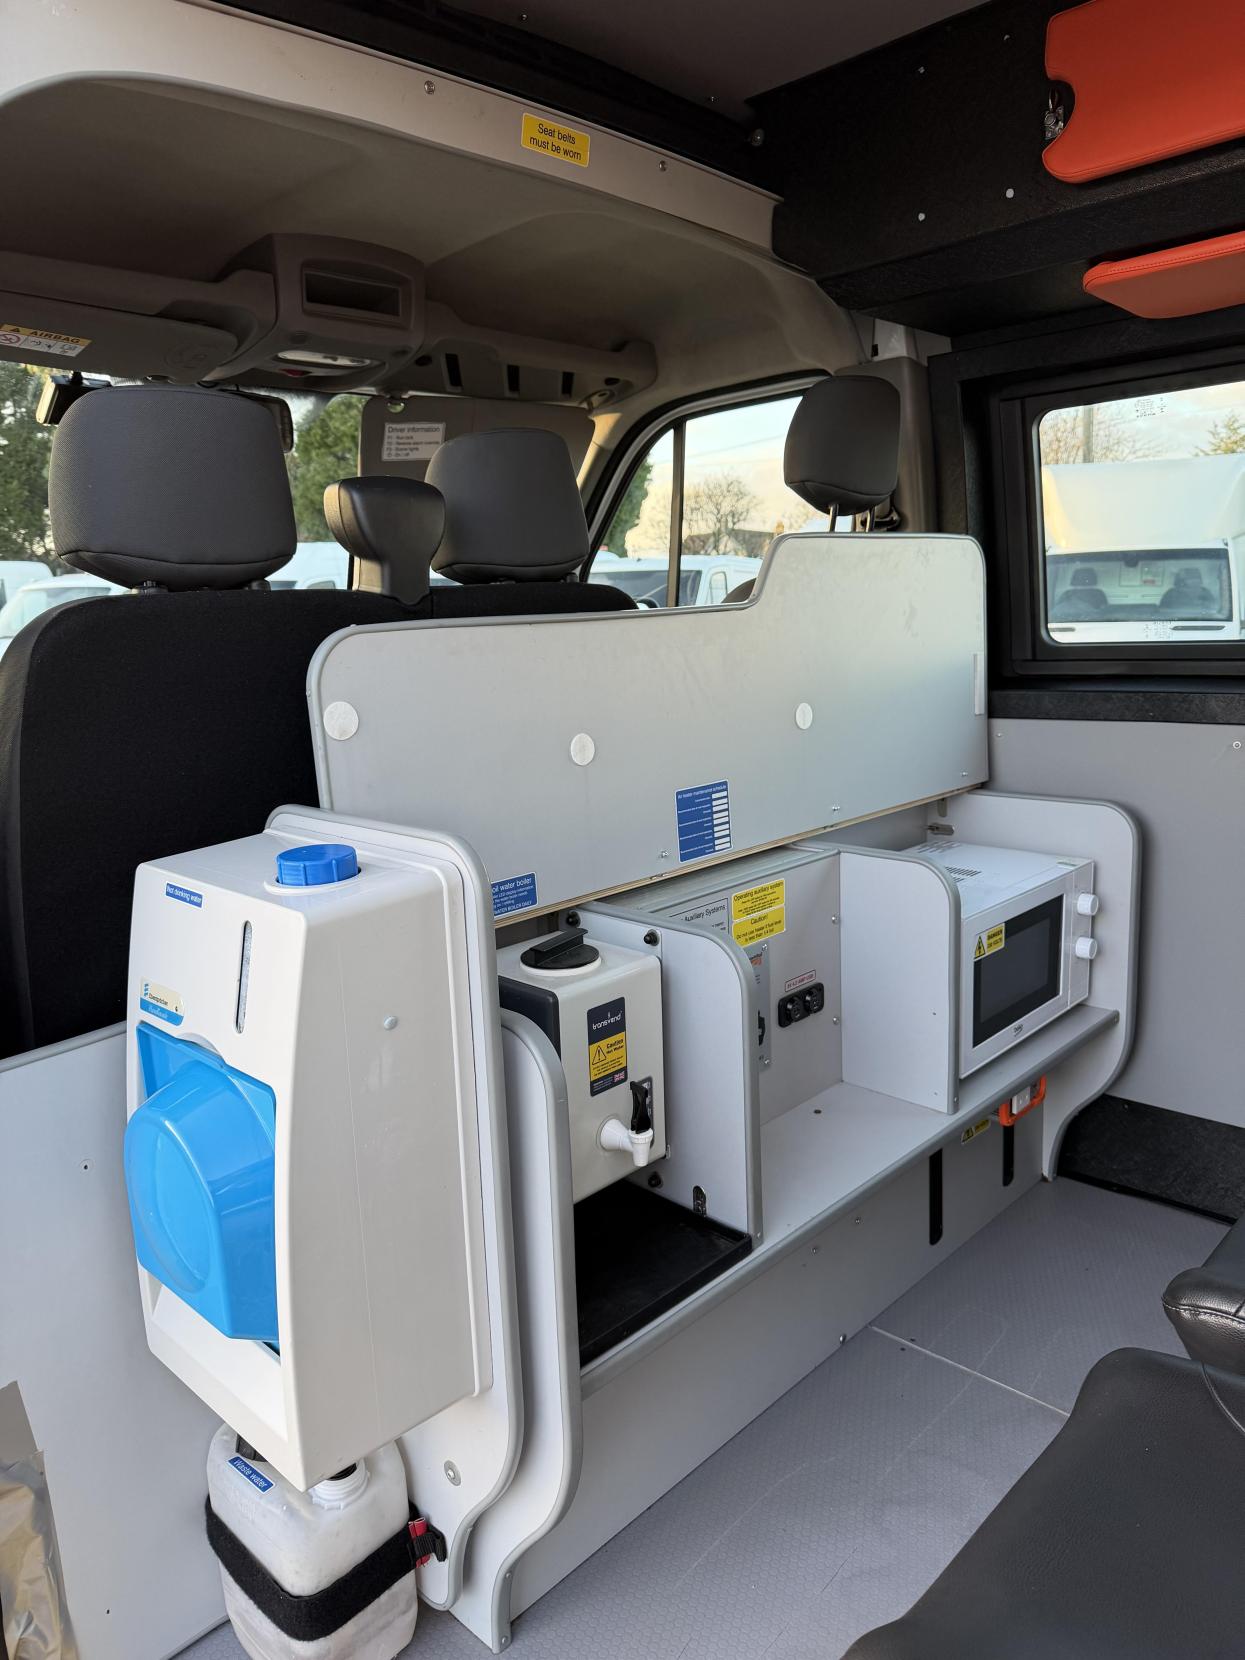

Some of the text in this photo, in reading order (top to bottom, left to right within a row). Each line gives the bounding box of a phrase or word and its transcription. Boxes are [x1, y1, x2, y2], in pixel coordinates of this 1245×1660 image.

[538, 123, 576, 145] Seat belts
[529, 136, 582, 161] must be worn
[30, 330, 81, 344] AIRBAG
[387, 425, 441, 433] Driver information
[713, 784, 727, 792] schedule
[500, 881, 516, 891] water
[516, 877, 532, 887] boiler
[733, 889, 754, 902] Operating
[754, 885, 769, 895] auxiliary
[769, 881, 784, 891] system
[174, 888, 190, 902] drinking
[190, 895, 202, 903] water
[684, 910, 705, 922] Auxiliary
[705, 903, 726, 917] Systems
[750, 913, 769, 925] Caution!
[592, 1013, 622, 1030] transvend
[606, 1038, 624, 1049] Caution
[233, 1459, 268, 1488] Waste water
